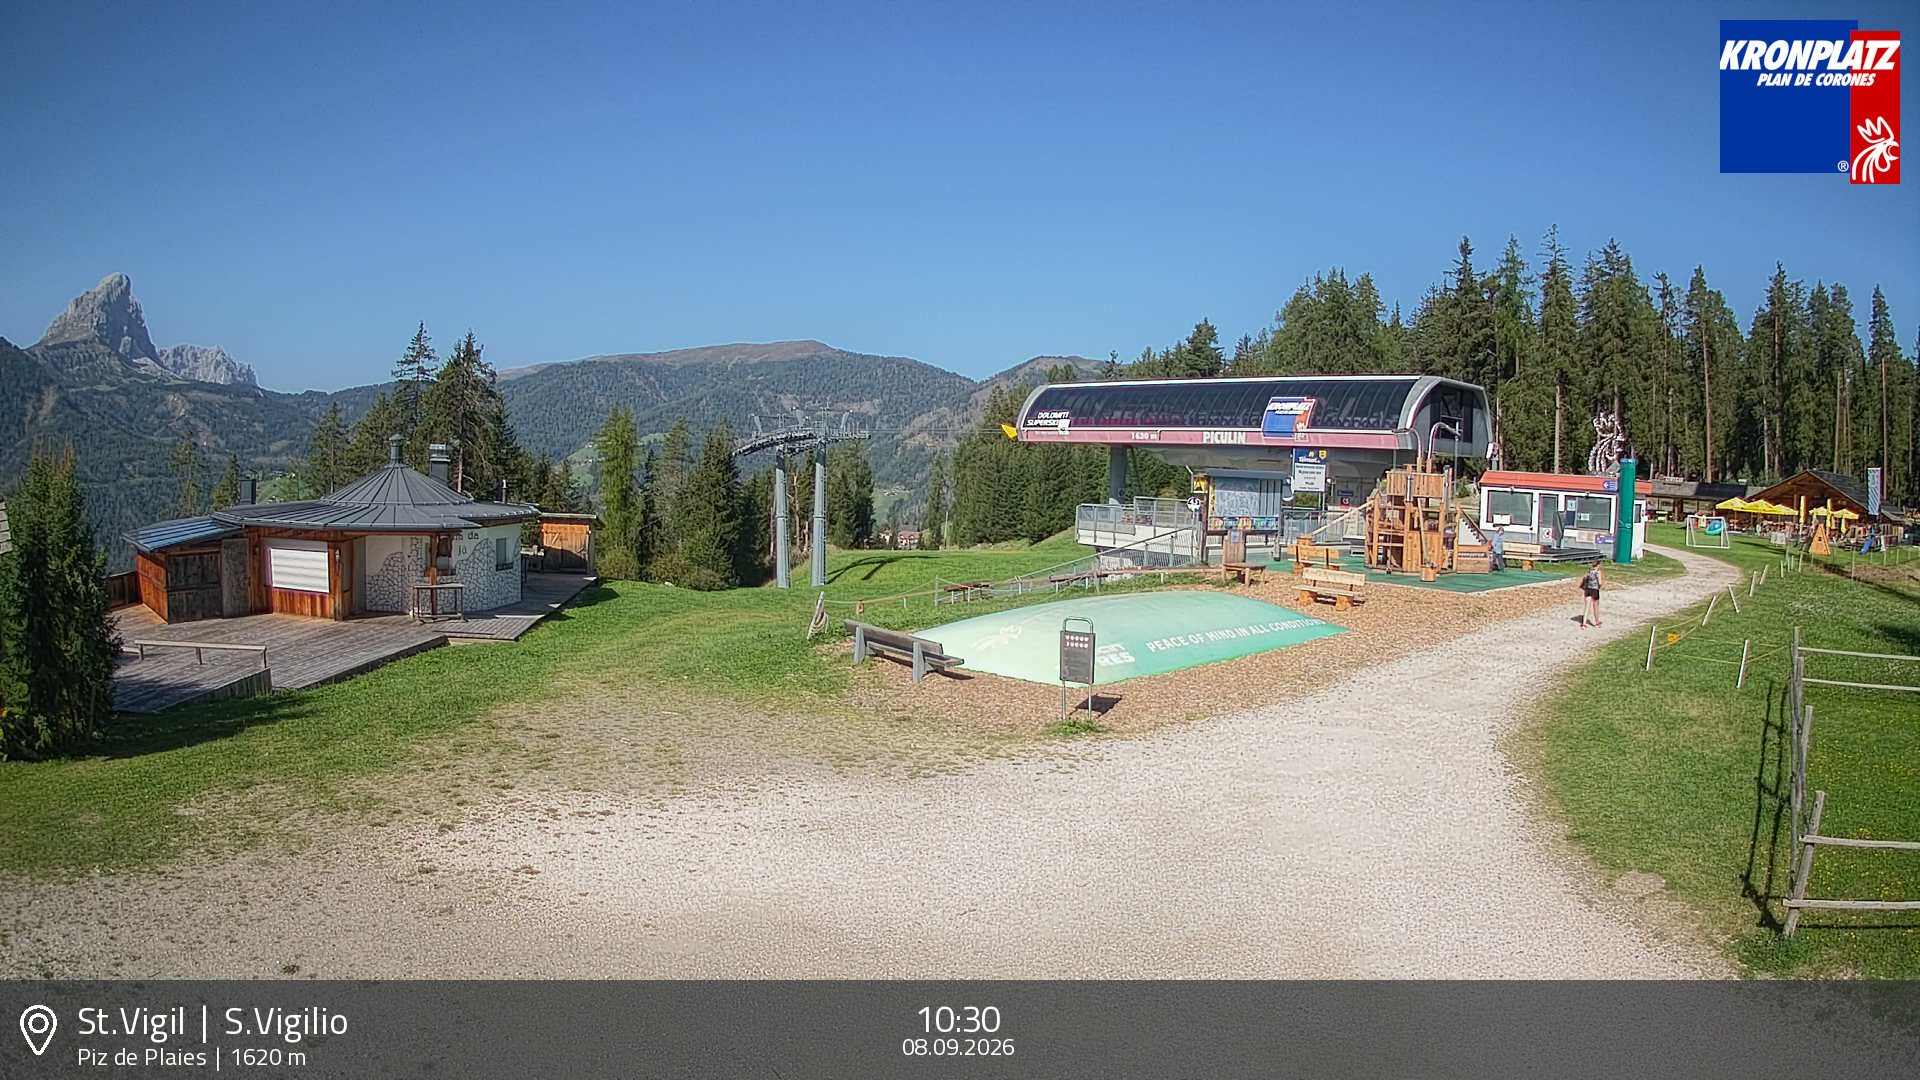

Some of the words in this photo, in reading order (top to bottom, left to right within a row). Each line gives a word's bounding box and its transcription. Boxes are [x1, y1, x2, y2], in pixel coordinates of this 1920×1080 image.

[1037, 411, 1069, 419] DOLOMITI
[1202, 431, 1246, 444] PICULIN
[1146, 635, 1189, 652] PEACE
[1187, 632, 1206, 646] OF
[1206, 628, 1236, 641] MIND
[1235, 626, 1249, 638] IN
[1249, 623, 1271, 636] ALL
